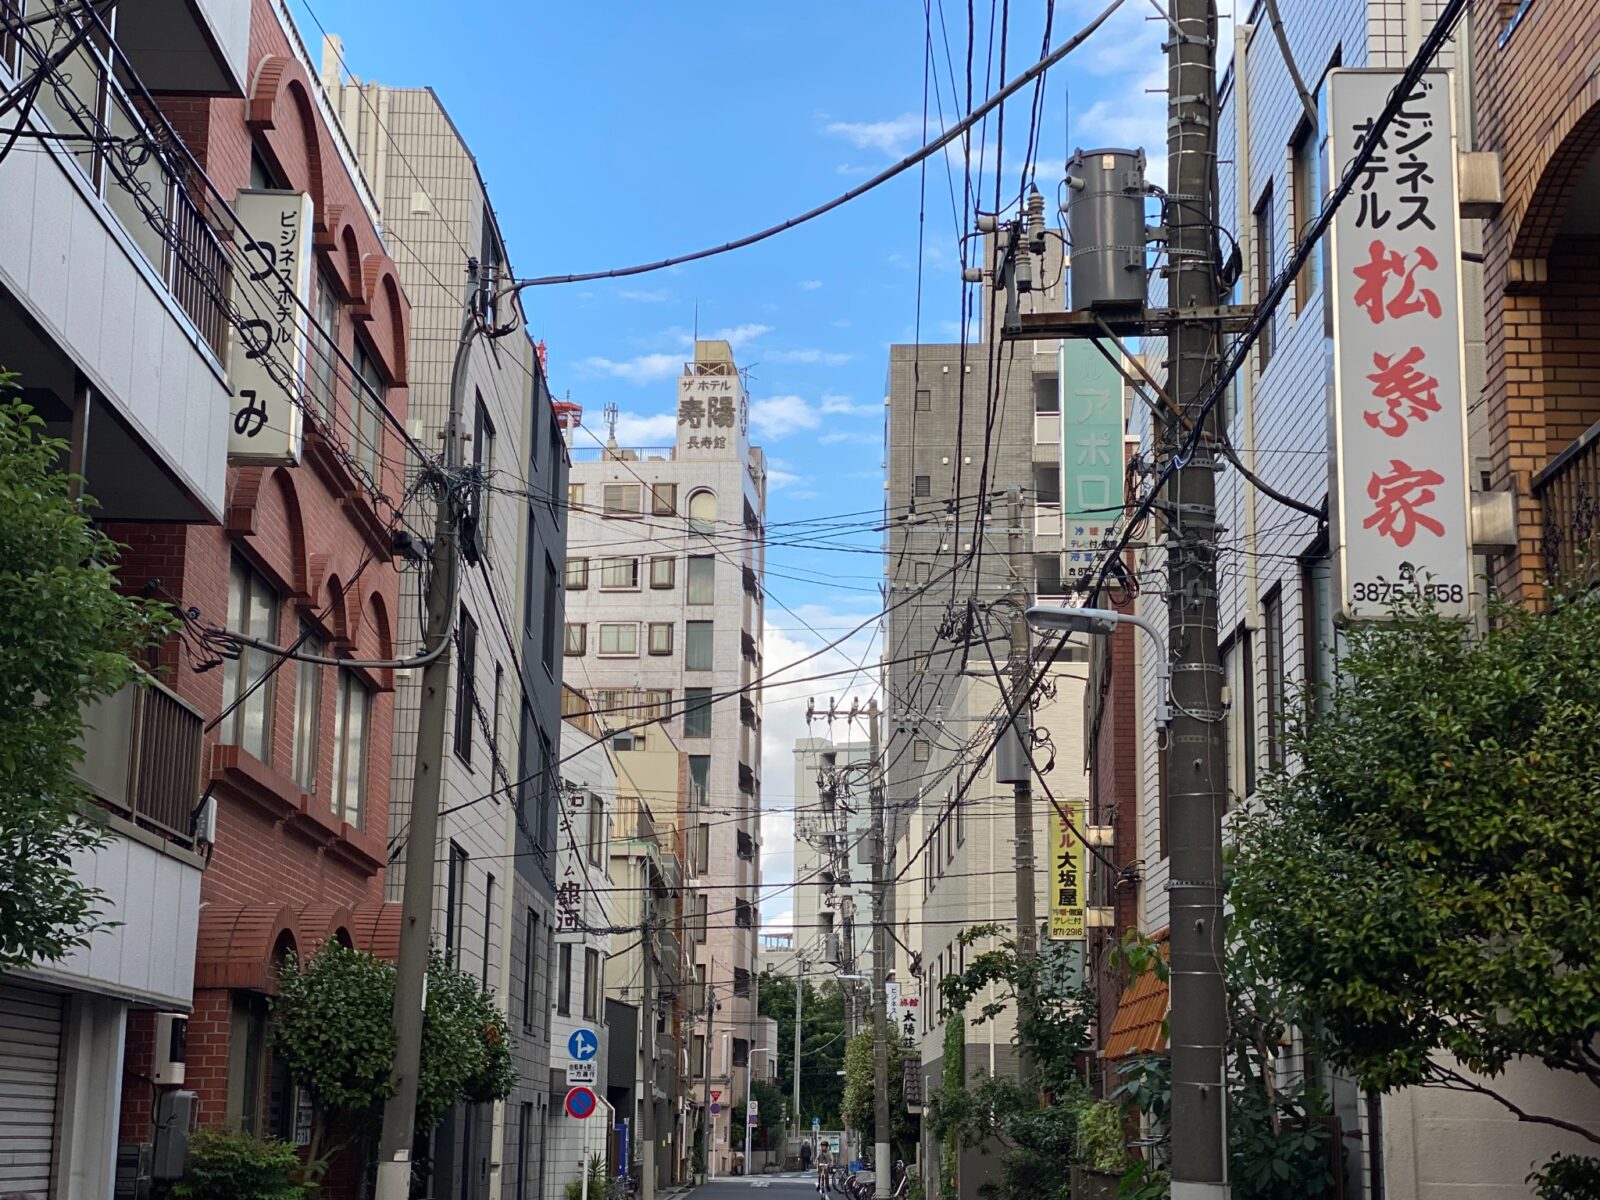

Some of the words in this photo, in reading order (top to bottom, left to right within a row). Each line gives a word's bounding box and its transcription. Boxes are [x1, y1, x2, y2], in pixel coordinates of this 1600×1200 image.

[1352, 117, 1392, 230] ホテル
[1395, 82, 1436, 231] ビジネス
[274, 210, 298, 345] ビジネスホテル
[234, 241, 277, 438] つつみ
[677, 396, 736, 429] 寿陽
[687, 436, 726, 449] 長寿館
[1059, 804, 1076, 849] ホテル
[1057, 851, 1077, 906] 大坂屋
